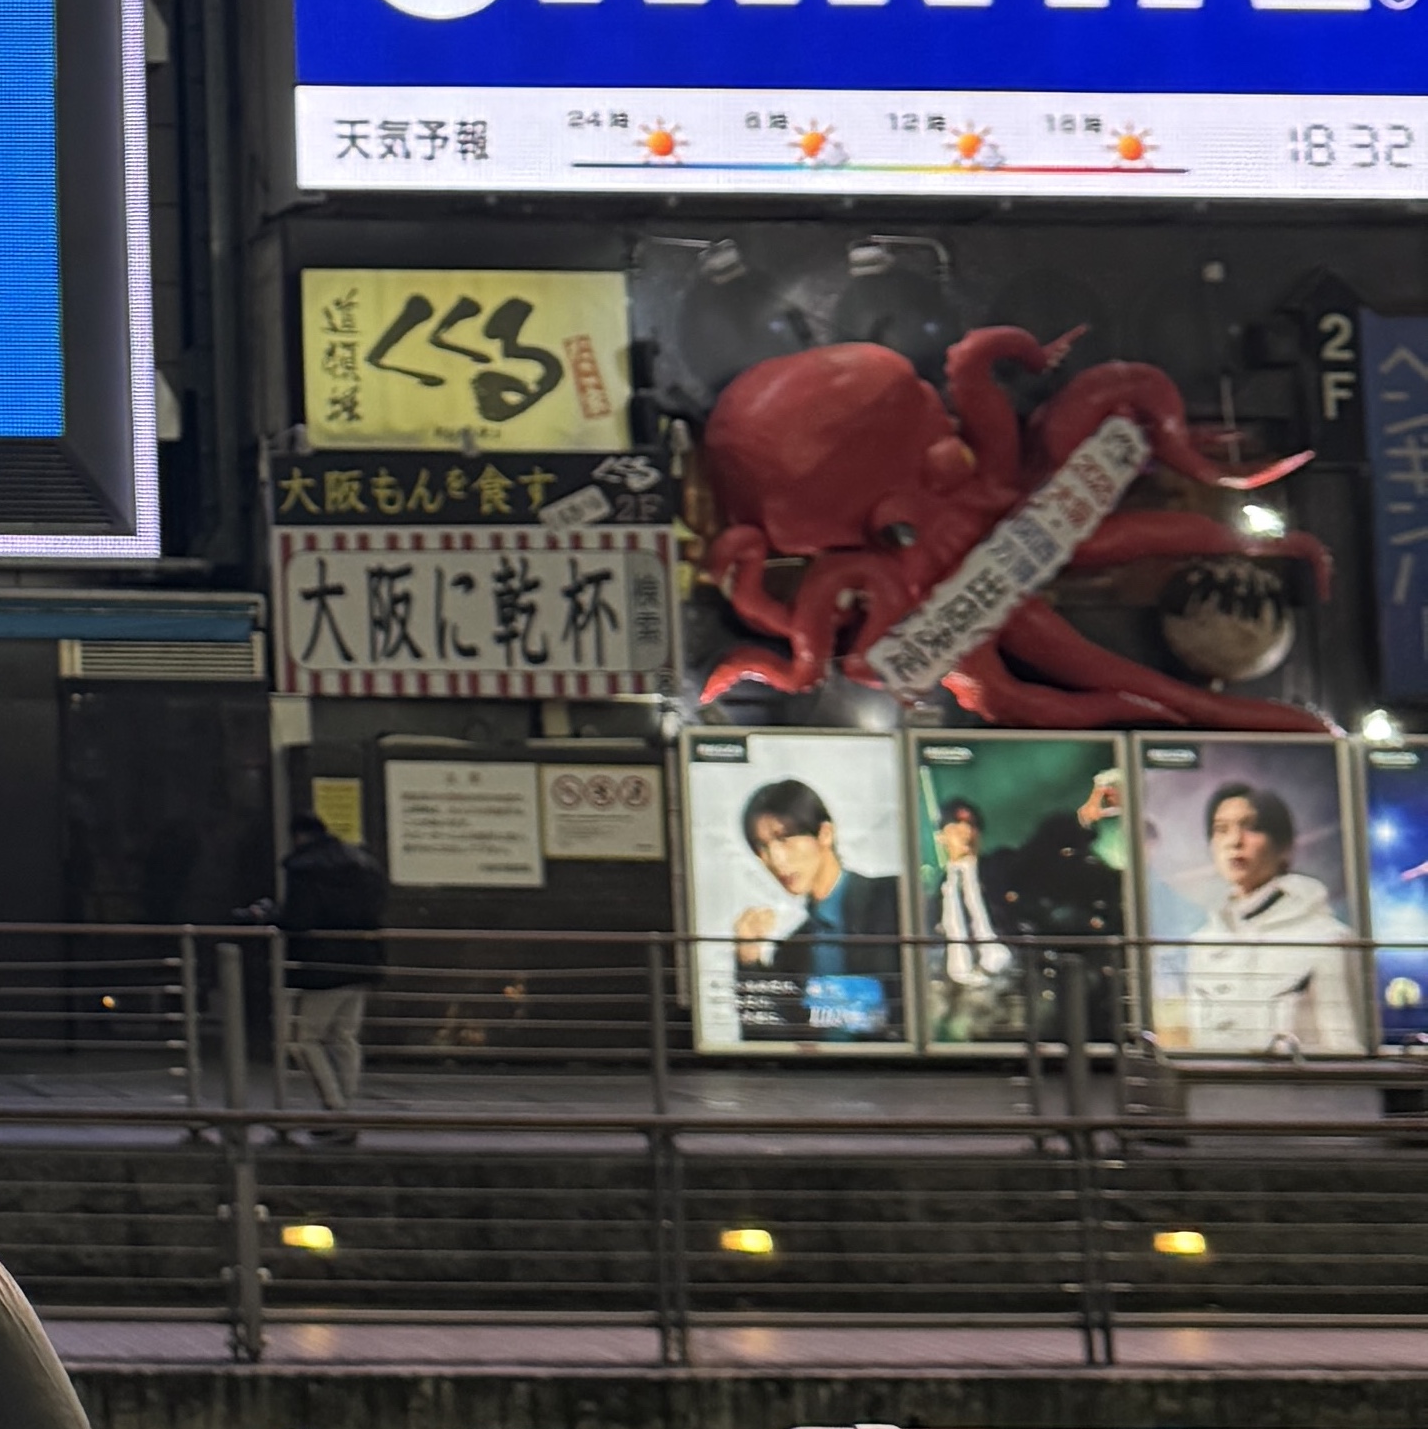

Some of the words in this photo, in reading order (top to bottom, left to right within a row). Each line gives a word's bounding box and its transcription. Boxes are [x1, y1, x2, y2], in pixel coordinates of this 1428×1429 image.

[334, 119, 490, 161] 天気予報
[364, 293, 564, 423] くくる
[300, 557, 620, 667] 大阪に乾杯
